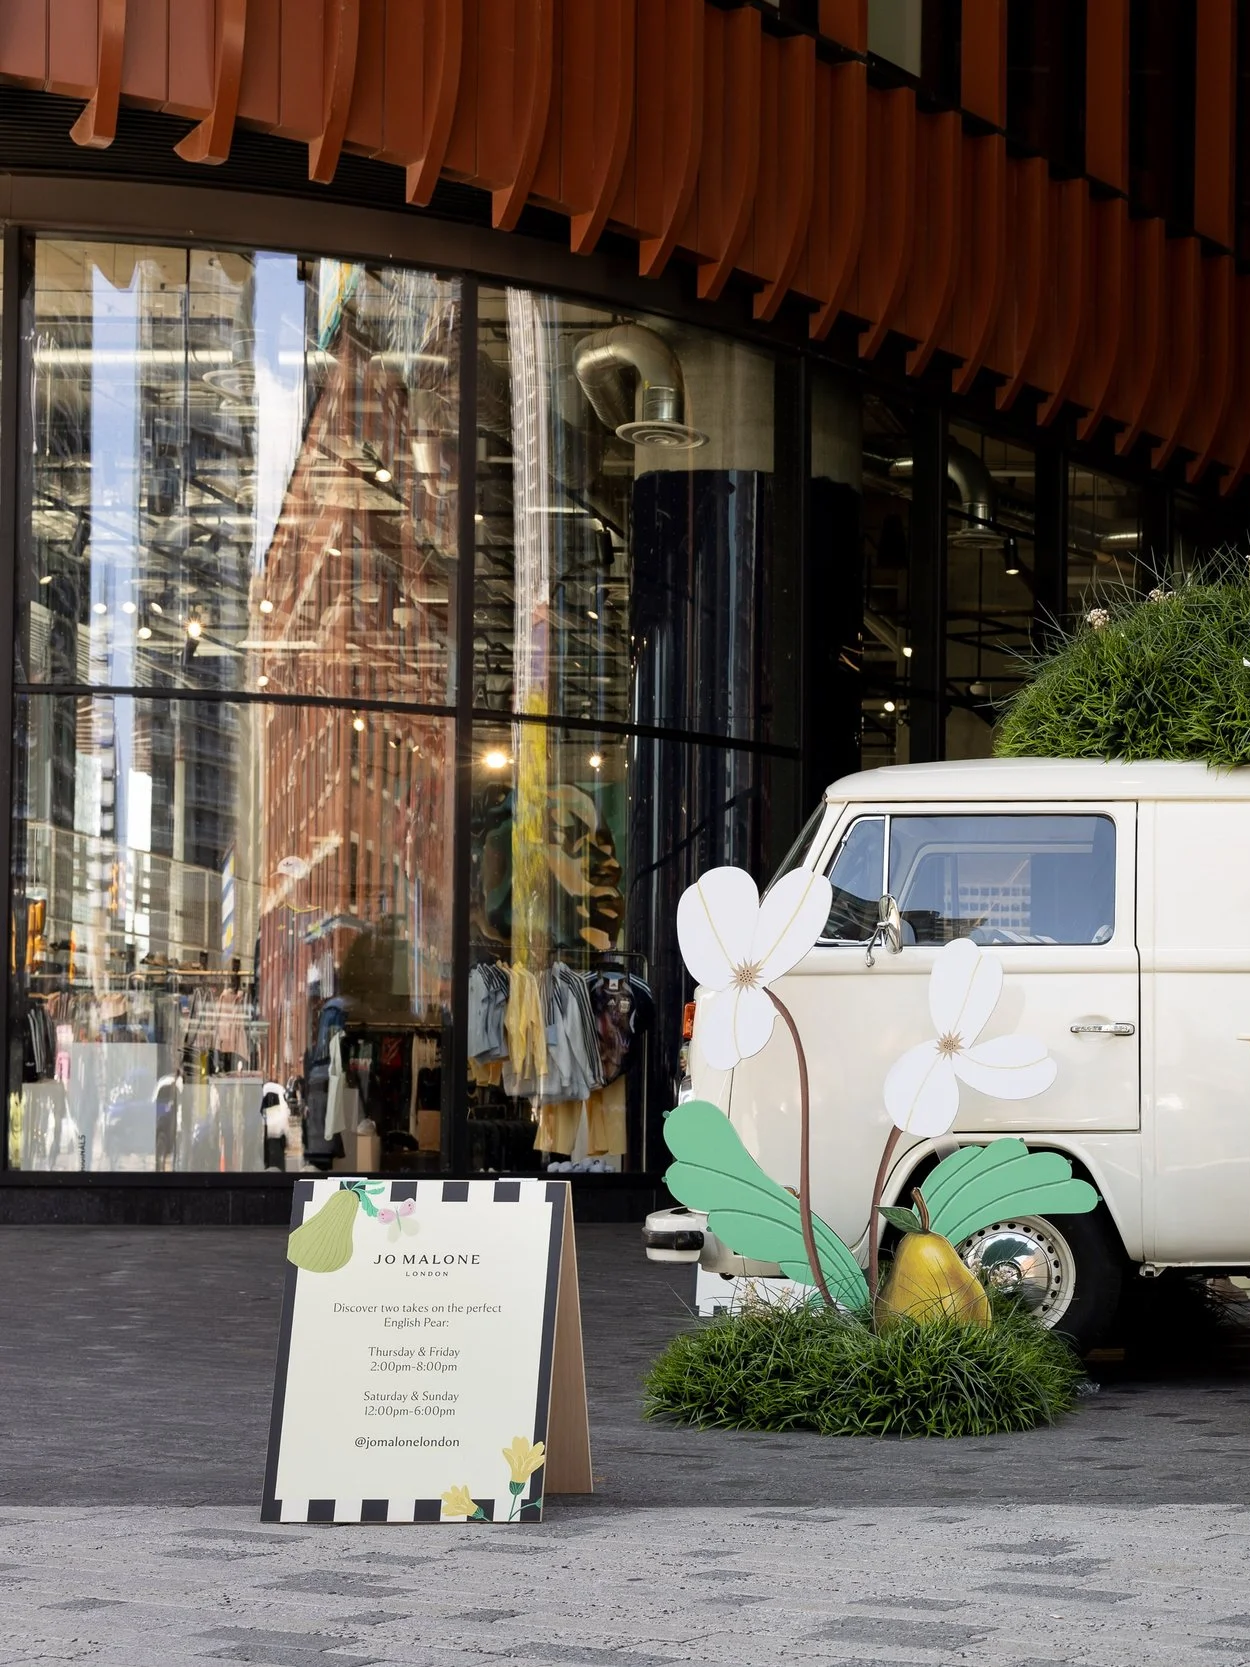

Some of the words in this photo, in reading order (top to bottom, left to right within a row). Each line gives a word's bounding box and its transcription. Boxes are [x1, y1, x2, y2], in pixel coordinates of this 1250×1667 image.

[373, 1254, 397, 1265] JO
[402, 1254, 481, 1265] MALONE
[333, 1302, 377, 1313] Discover
[381, 1304, 400, 1313] two
[402, 1302, 429, 1313] takes
[431, 1305, 445, 1313] on
[447, 1302, 464, 1313] the
[466, 1302, 502, 1315] perfect
[384, 1318, 421, 1329] English
[423, 1318, 450, 1328] Pear:
[368, 1346, 415, 1359] Thursday
[418, 1347, 427, 1357] &
[429, 1346, 460, 1359] Friday
[370, 1361, 458, 1374] 2:00pm-8:00pm
[364, 1390, 408, 1403] Saturday
[411, 1391, 420, 1401] &
[422, 1390, 459, 1403] Sunday
[364, 1405, 456, 1418] 12:00pm-6:00pm
[354, 1436, 460, 1449] @jomalonelondon
